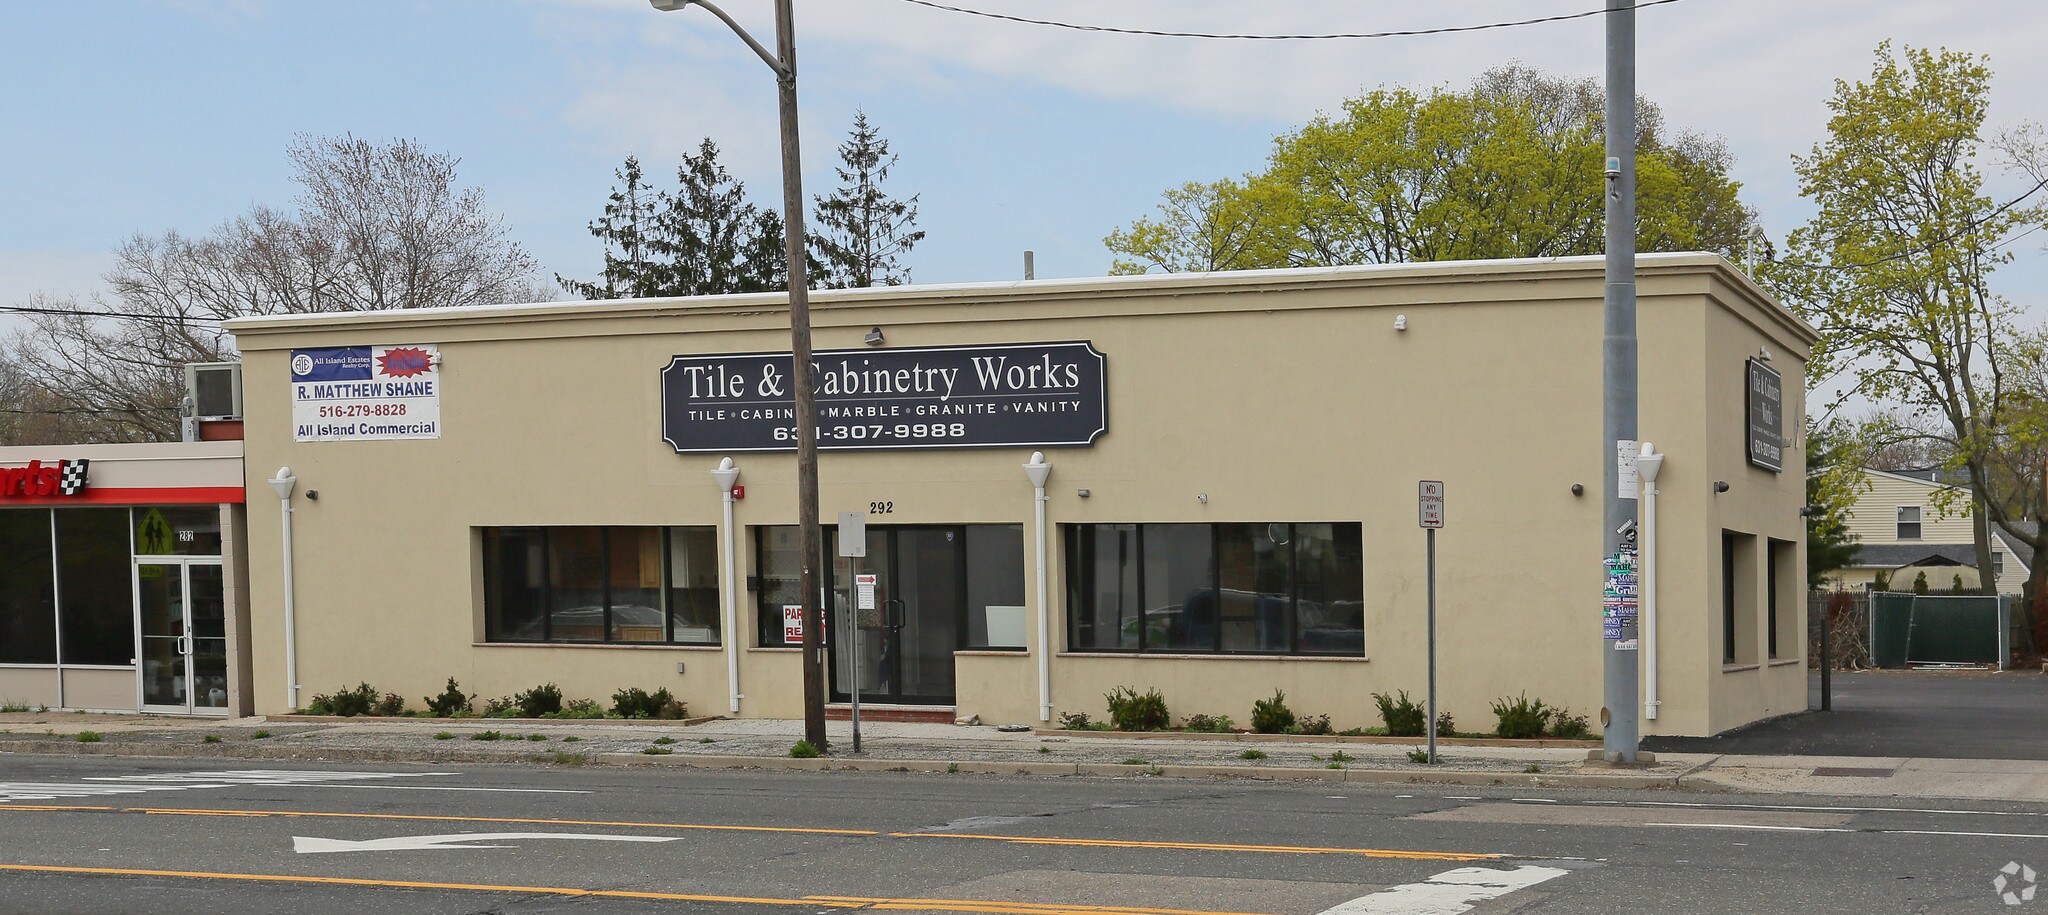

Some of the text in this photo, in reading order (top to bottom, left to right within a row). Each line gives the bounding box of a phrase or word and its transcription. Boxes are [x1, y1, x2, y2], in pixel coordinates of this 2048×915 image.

[314, 355, 371, 365] All Island Estates
[683, 363, 745, 399] Tile
[757, 362, 785, 399] &
[970, 352, 1080, 392] Works
[298, 381, 433, 399] R. MATTHEW SHANE
[319, 403, 407, 418] 516-279-8828
[688, 400, 1081, 421] TILE CABIN MARBLE GRANITE VANITY
[297, 421, 435, 437] All Island Commercial
[1426, 484, 1436, 495] NO
[1420, 495, 1442, 503] STOPPING
[870, 501, 894, 514] 292
[180, 531, 194, 541] 282
